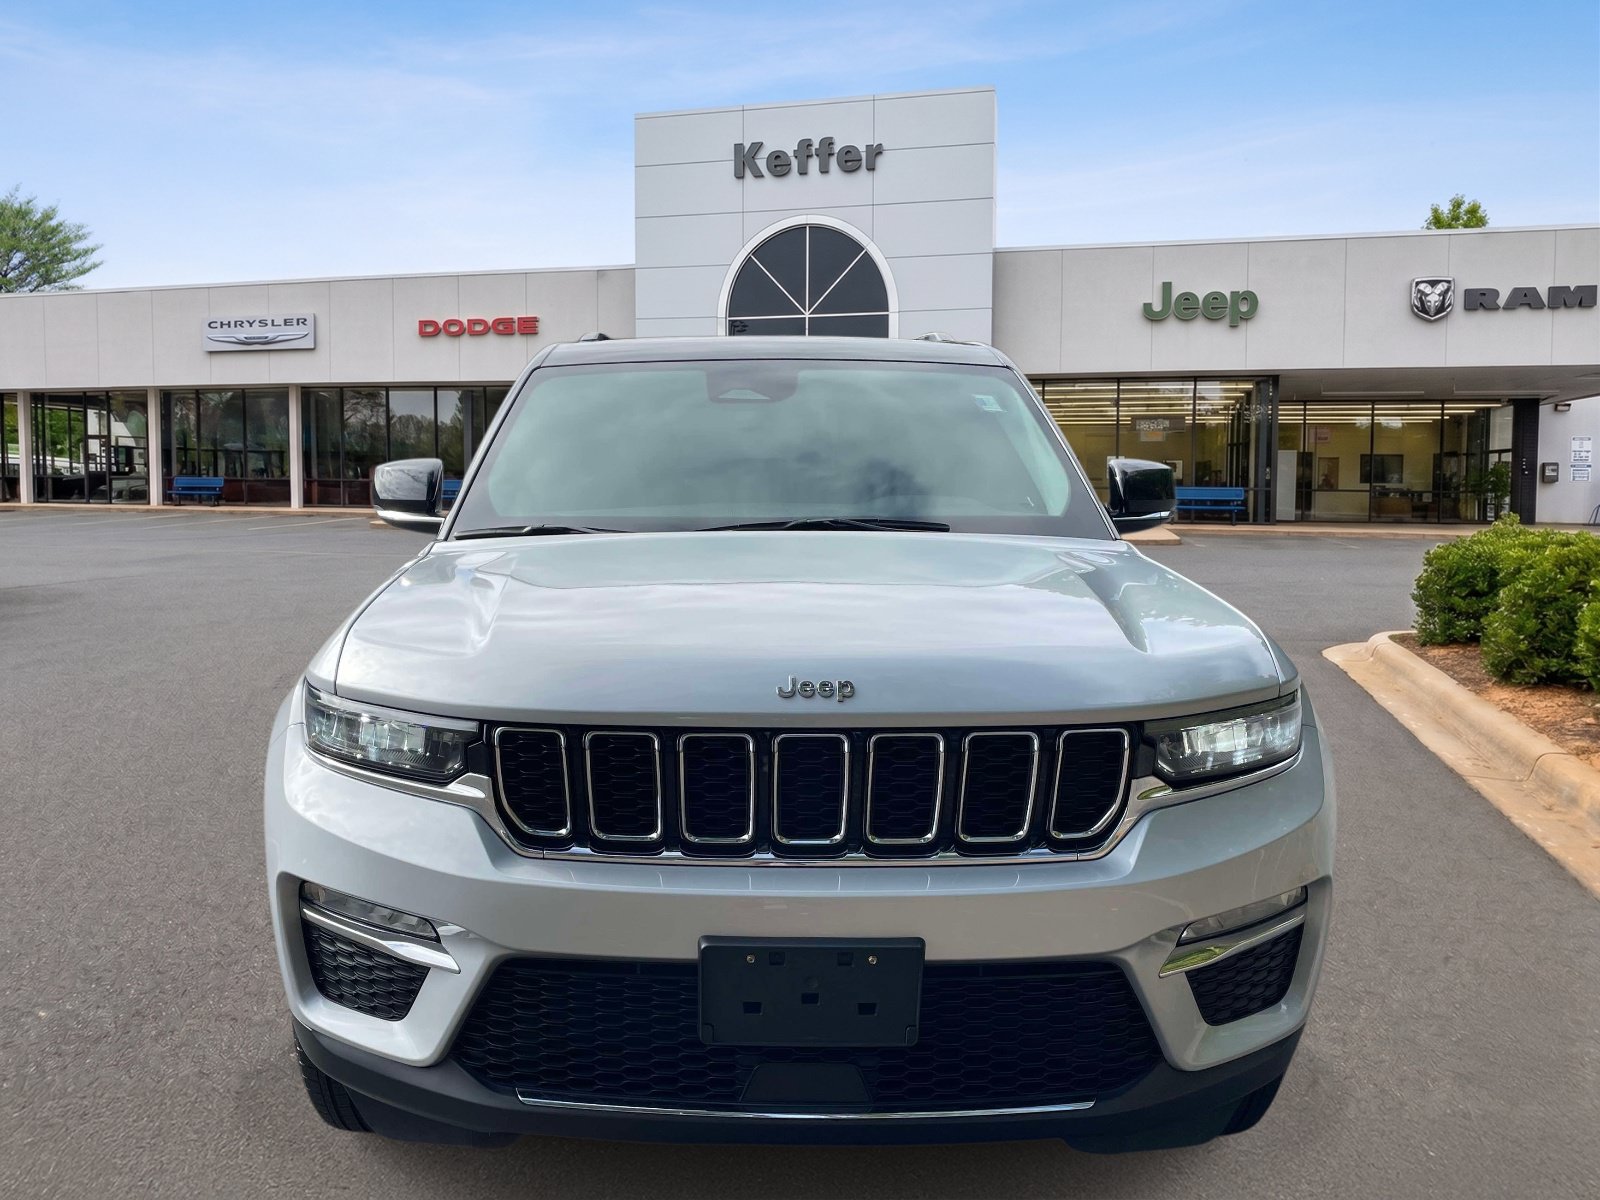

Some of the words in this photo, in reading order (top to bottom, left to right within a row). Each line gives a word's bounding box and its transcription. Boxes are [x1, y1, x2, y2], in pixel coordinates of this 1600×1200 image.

[733, 136, 884, 179] Keffer
[1143, 281, 1259, 328] Jeep
[1464, 285, 1597, 311] RAM
[207, 317, 309, 329] CHRYSLER
[418, 316, 539, 337] DODGE
[776, 674, 855, 702] Jeep
